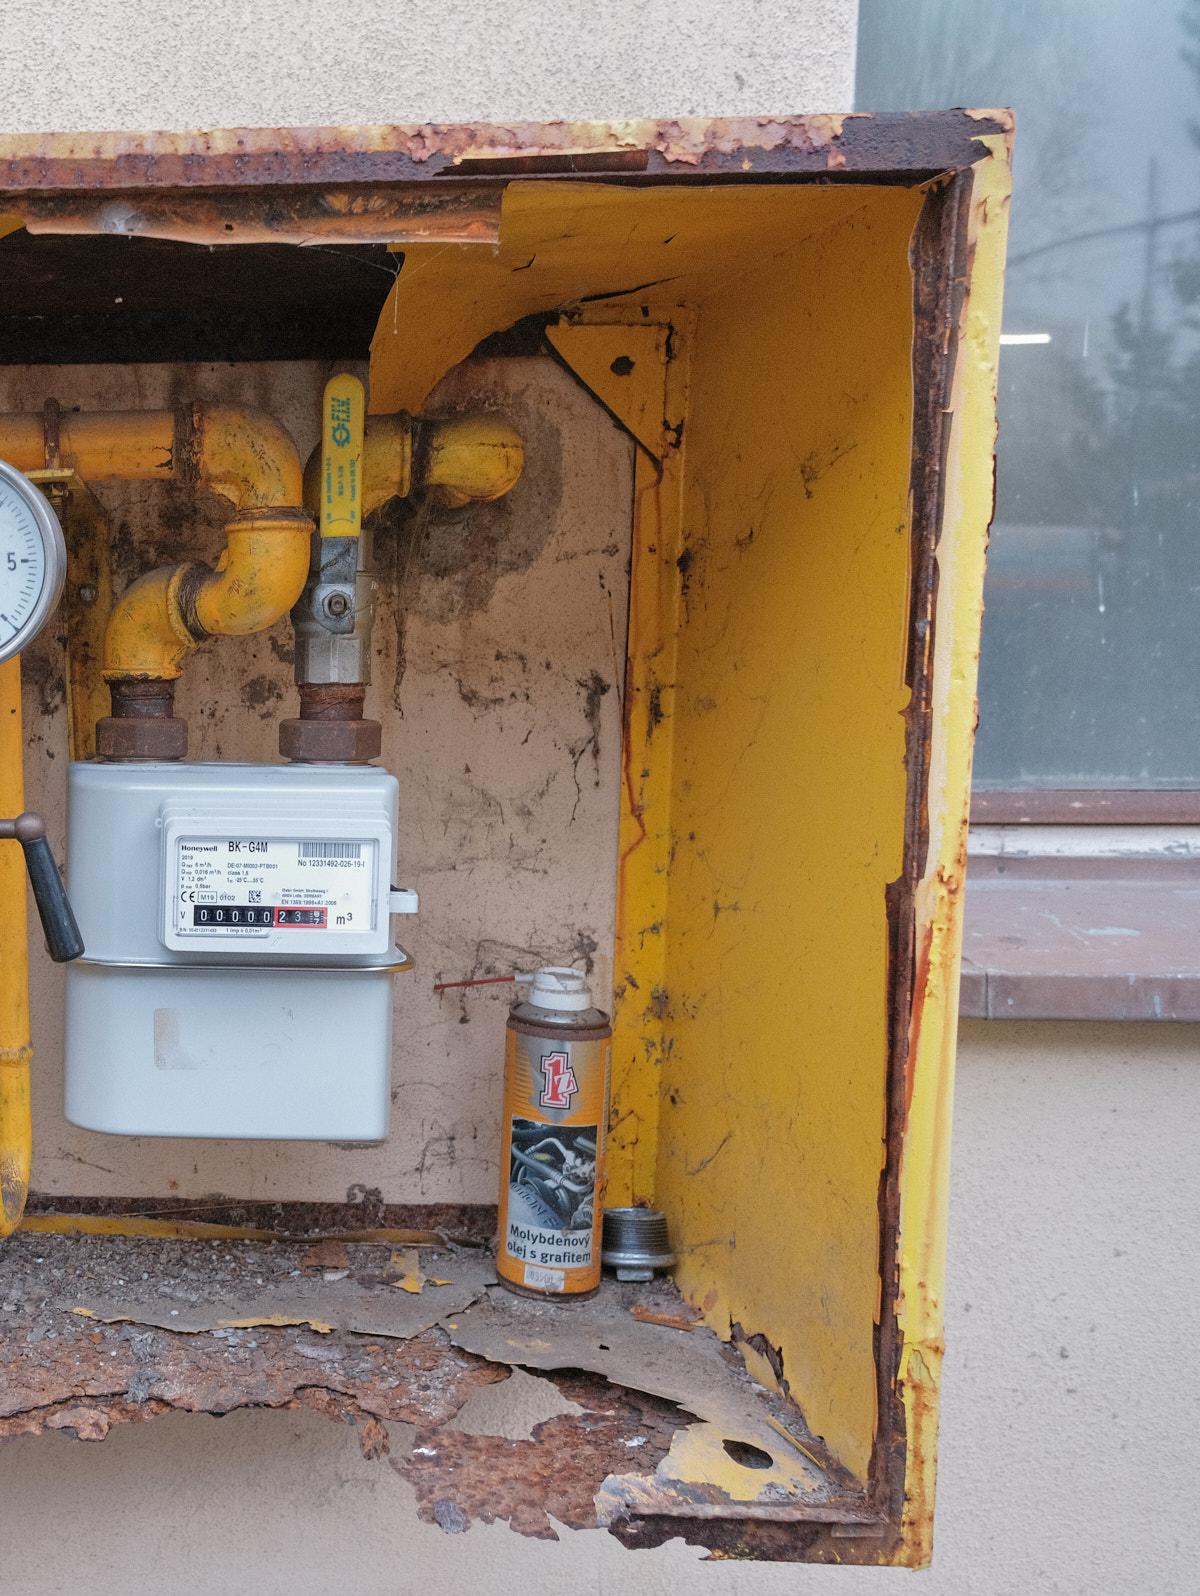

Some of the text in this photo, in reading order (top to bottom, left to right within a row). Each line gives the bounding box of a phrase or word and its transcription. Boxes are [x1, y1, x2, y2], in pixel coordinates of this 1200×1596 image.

[7, 552, 16, 571] 5
[298, 859, 306, 867] No
[180, 911, 186, 919] V
[510, 1223, 591, 1249] Molybdenový
[507, 1241, 591, 1264] olej s grafitem
